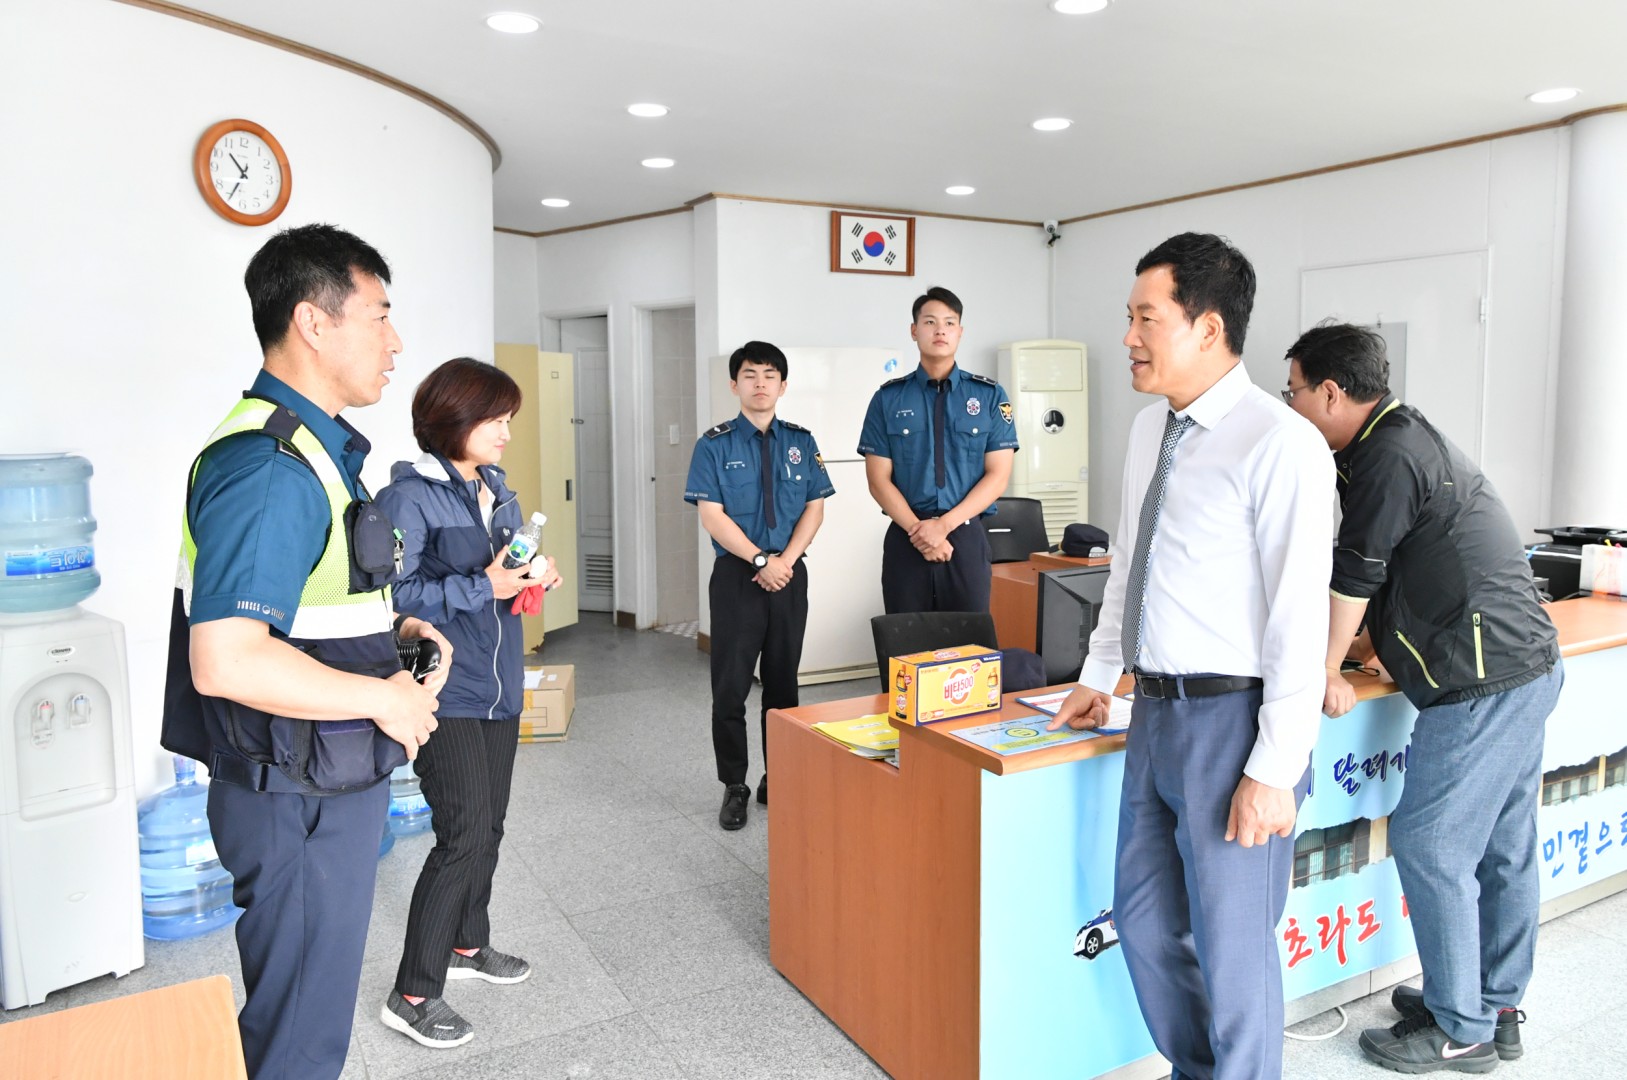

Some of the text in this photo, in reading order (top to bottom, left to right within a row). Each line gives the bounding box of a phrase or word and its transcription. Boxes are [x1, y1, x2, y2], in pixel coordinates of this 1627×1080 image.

[225, 137, 233, 149] 11
[240, 137, 249, 149] 12
[213, 147, 223, 159] 10
[210, 161, 219, 172] 9
[263, 158, 271, 170] 2
[216, 180, 224, 190] 8
[266, 174, 274, 186] 3
[262, 189, 269, 199] 4
[239, 200, 247, 210] 6
[253, 196, 261, 208] 5
[943, 675, 974, 699] 비타500
